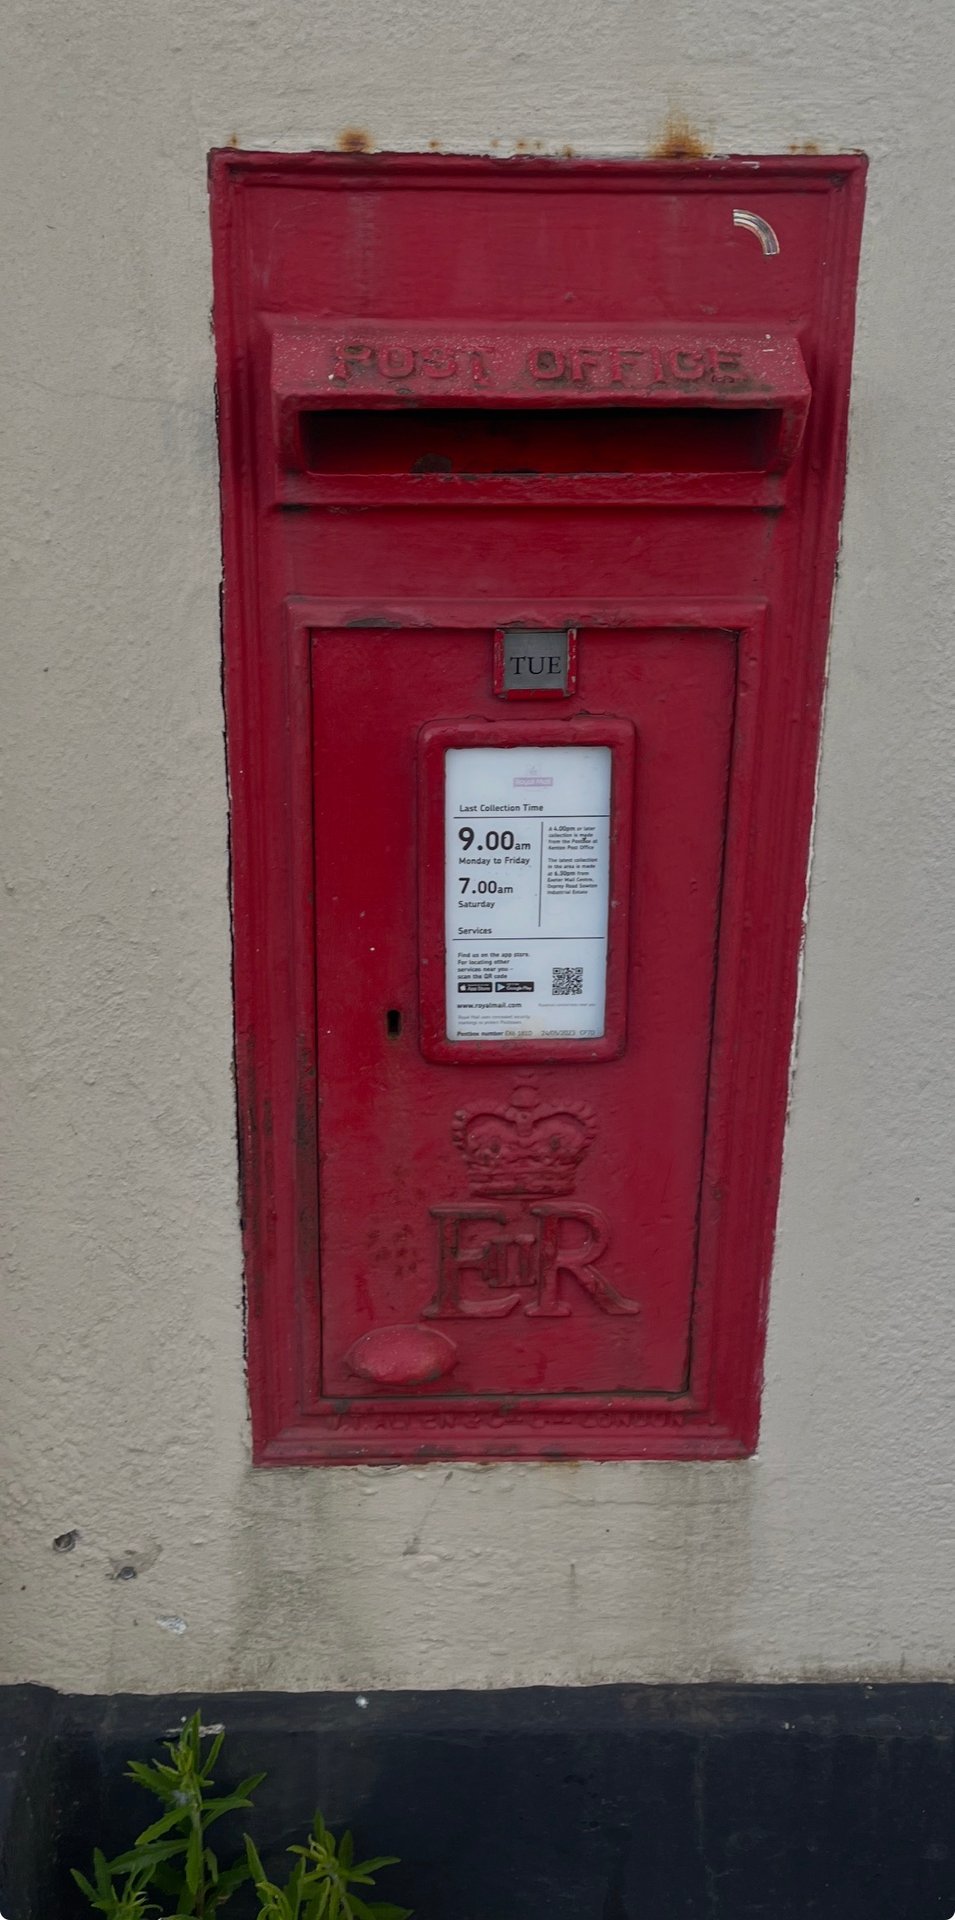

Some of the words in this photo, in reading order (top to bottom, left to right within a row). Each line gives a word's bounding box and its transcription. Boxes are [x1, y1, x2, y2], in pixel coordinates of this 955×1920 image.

[331, 345, 496, 384] POST
[527, 346, 746, 384] OFFICE
[510, 656, 562, 675] TUE
[459, 804, 478, 812] Last
[480, 804, 520, 812] Collection
[523, 803, 544, 811] Time
[459, 857, 491, 866] Monday
[505, 856, 530, 865] Friday
[458, 927, 493, 935] Services
